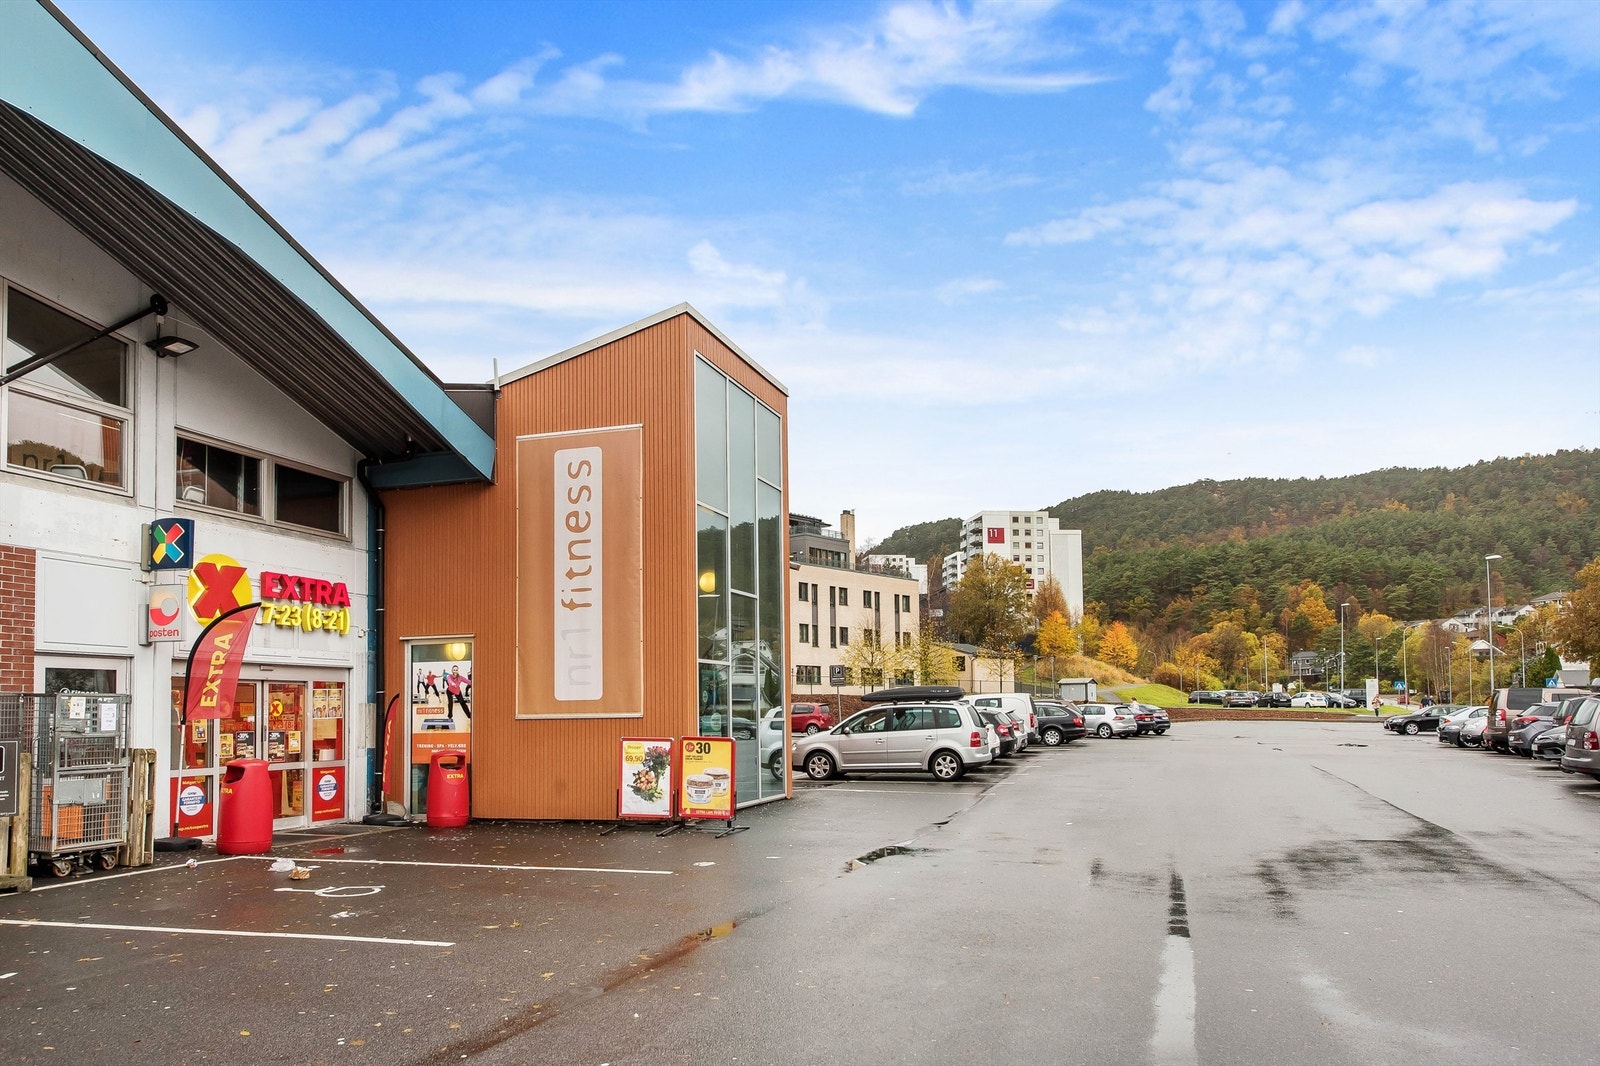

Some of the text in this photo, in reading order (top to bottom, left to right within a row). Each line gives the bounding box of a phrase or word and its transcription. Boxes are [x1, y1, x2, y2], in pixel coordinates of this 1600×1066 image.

[988, 529, 998, 538] 11
[560, 459, 592, 686] nr1 fitness
[261, 571, 351, 607] EXTRA
[149, 628, 180, 639] posten
[200, 633, 234, 707] EXTRA
[695, 742, 711, 754] 30
